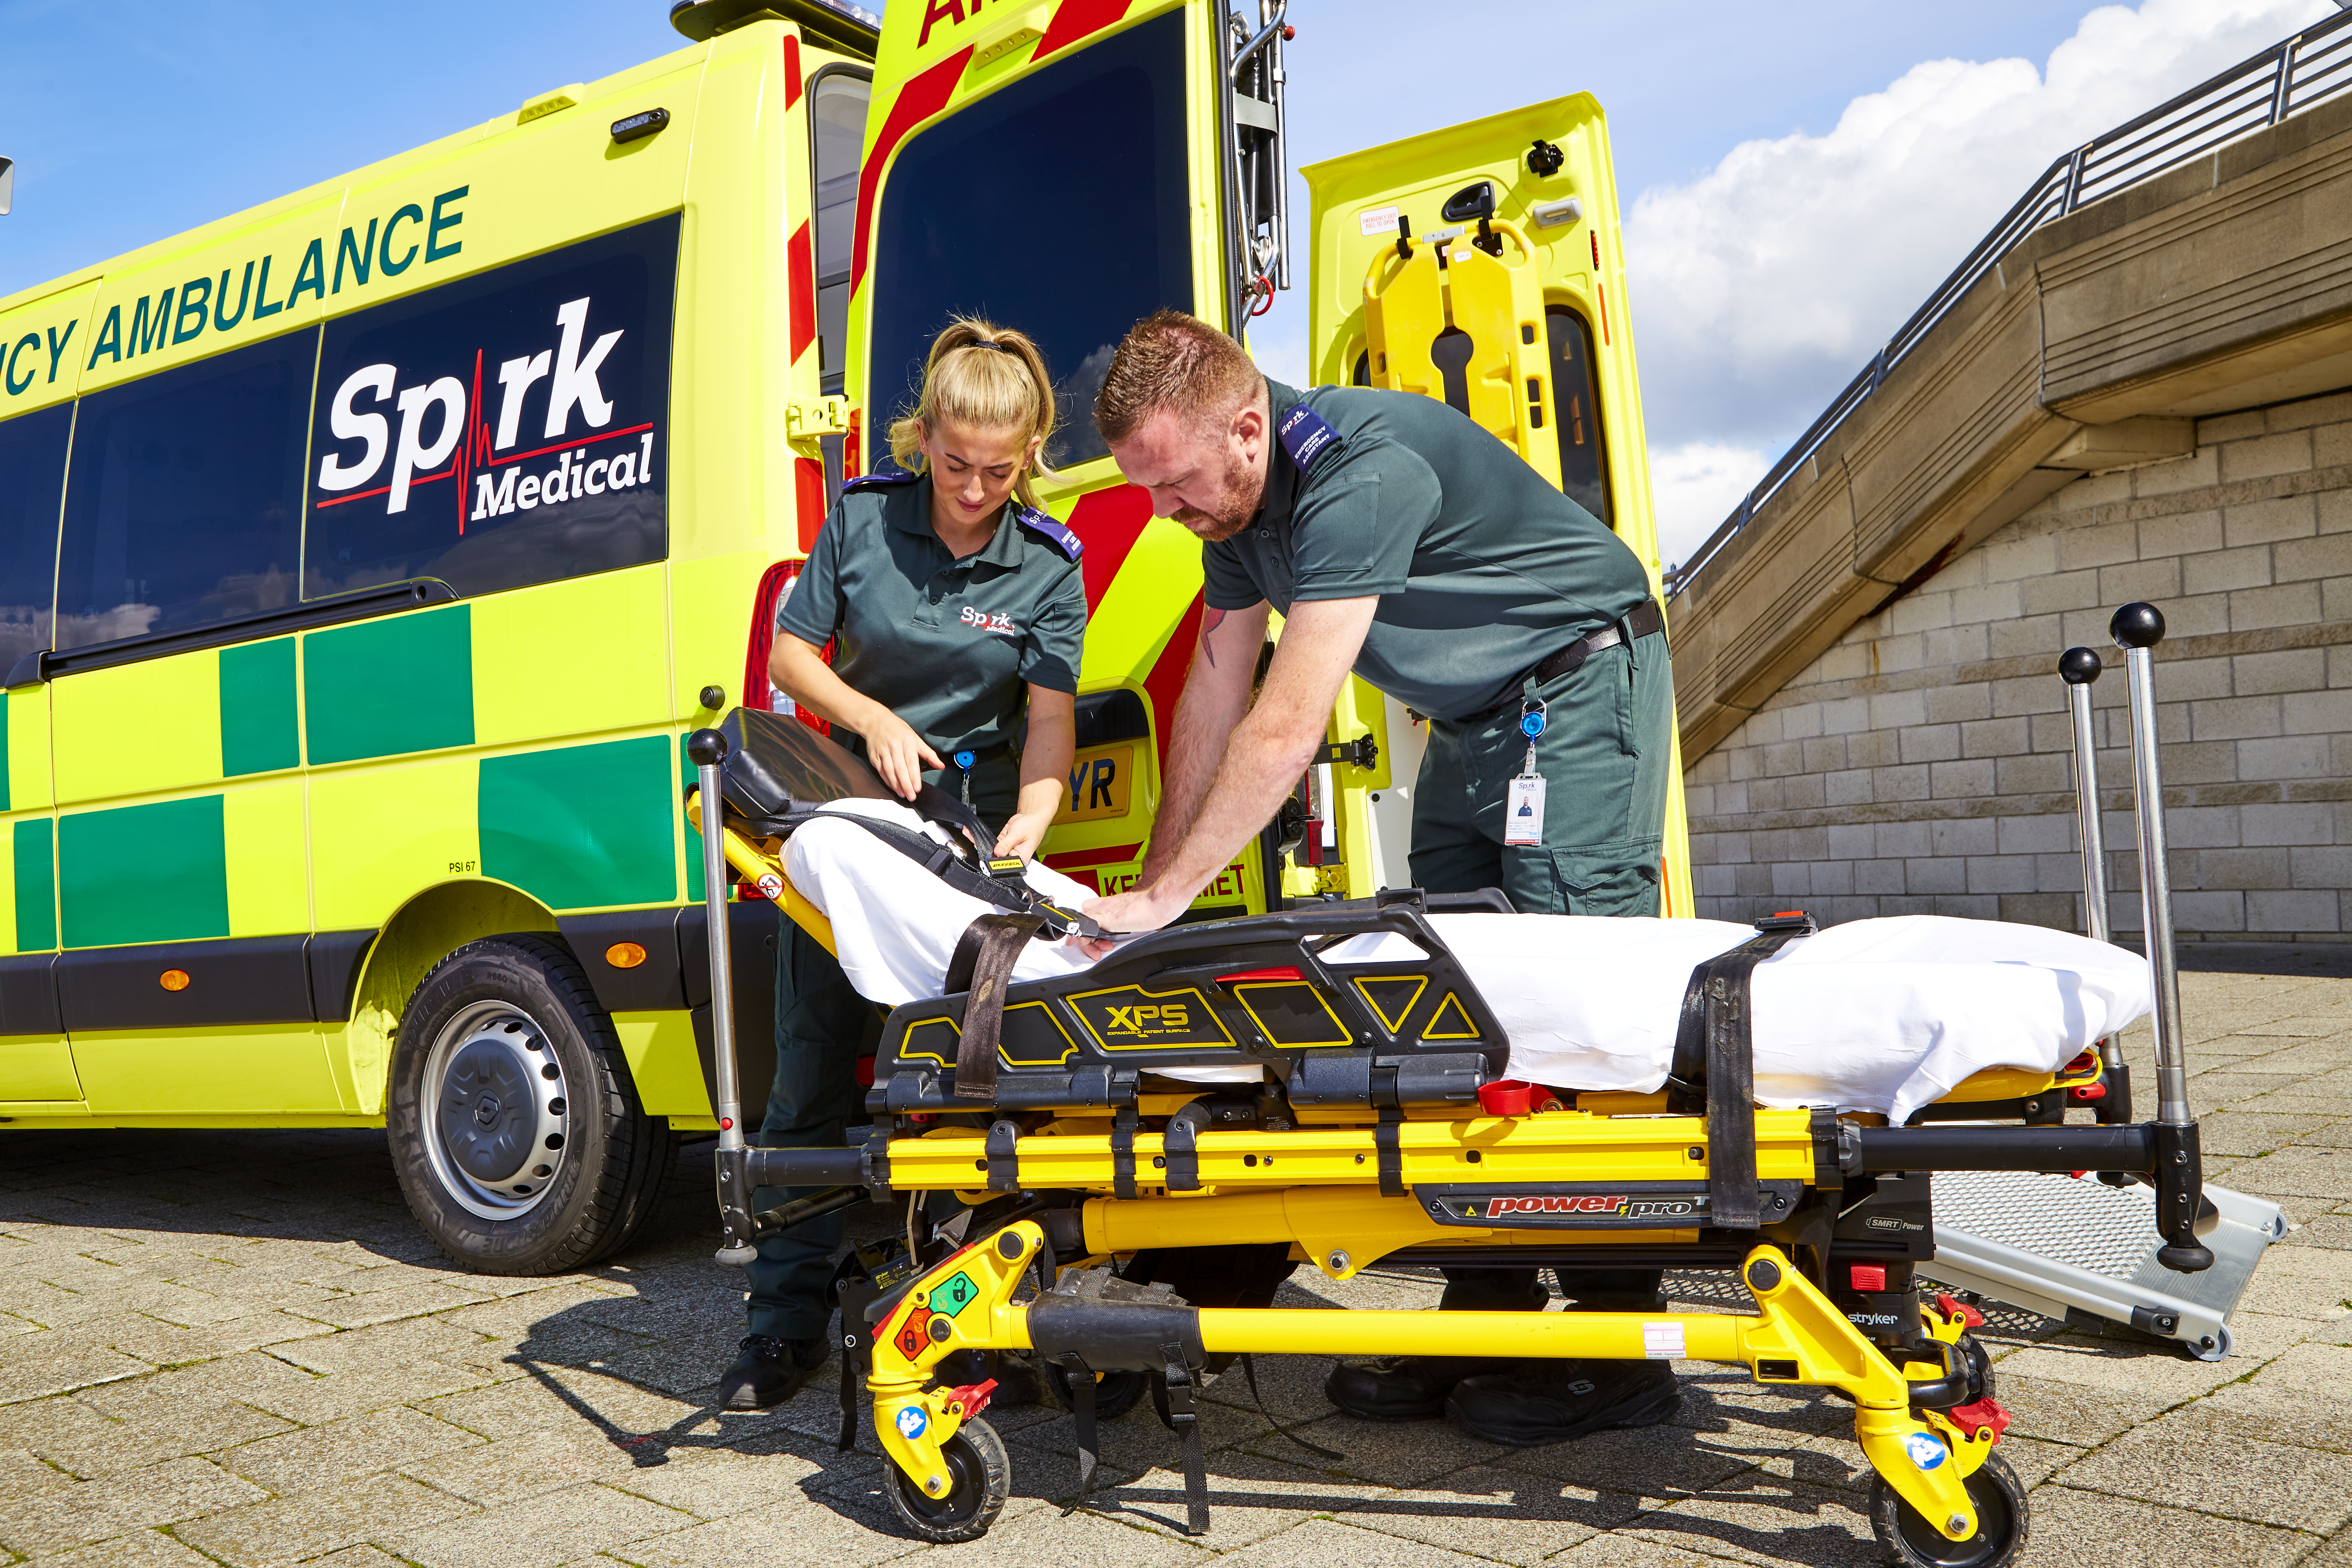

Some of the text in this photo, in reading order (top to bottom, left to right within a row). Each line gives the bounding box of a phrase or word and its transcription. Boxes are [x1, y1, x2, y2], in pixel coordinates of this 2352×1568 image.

[1363, 215, 1386, 224] EMERGENCY
[0, 184, 469, 395] CY AMBULANCE
[1295, 426, 1325, 459] EMERGENCY
[1303, 433, 1329, 465] ASSISTANT
[1305, 436, 1320, 452] CARE
[471, 432, 654, 521] Medical
[985, 625, 1015, 636] Medical
[450, 861, 475, 873] PSI 67
[1105, 1004, 1188, 1031] XPS
[1872, 1219, 1924, 1231] SMRT Power
[1848, 1312, 1898, 1325] stryker
